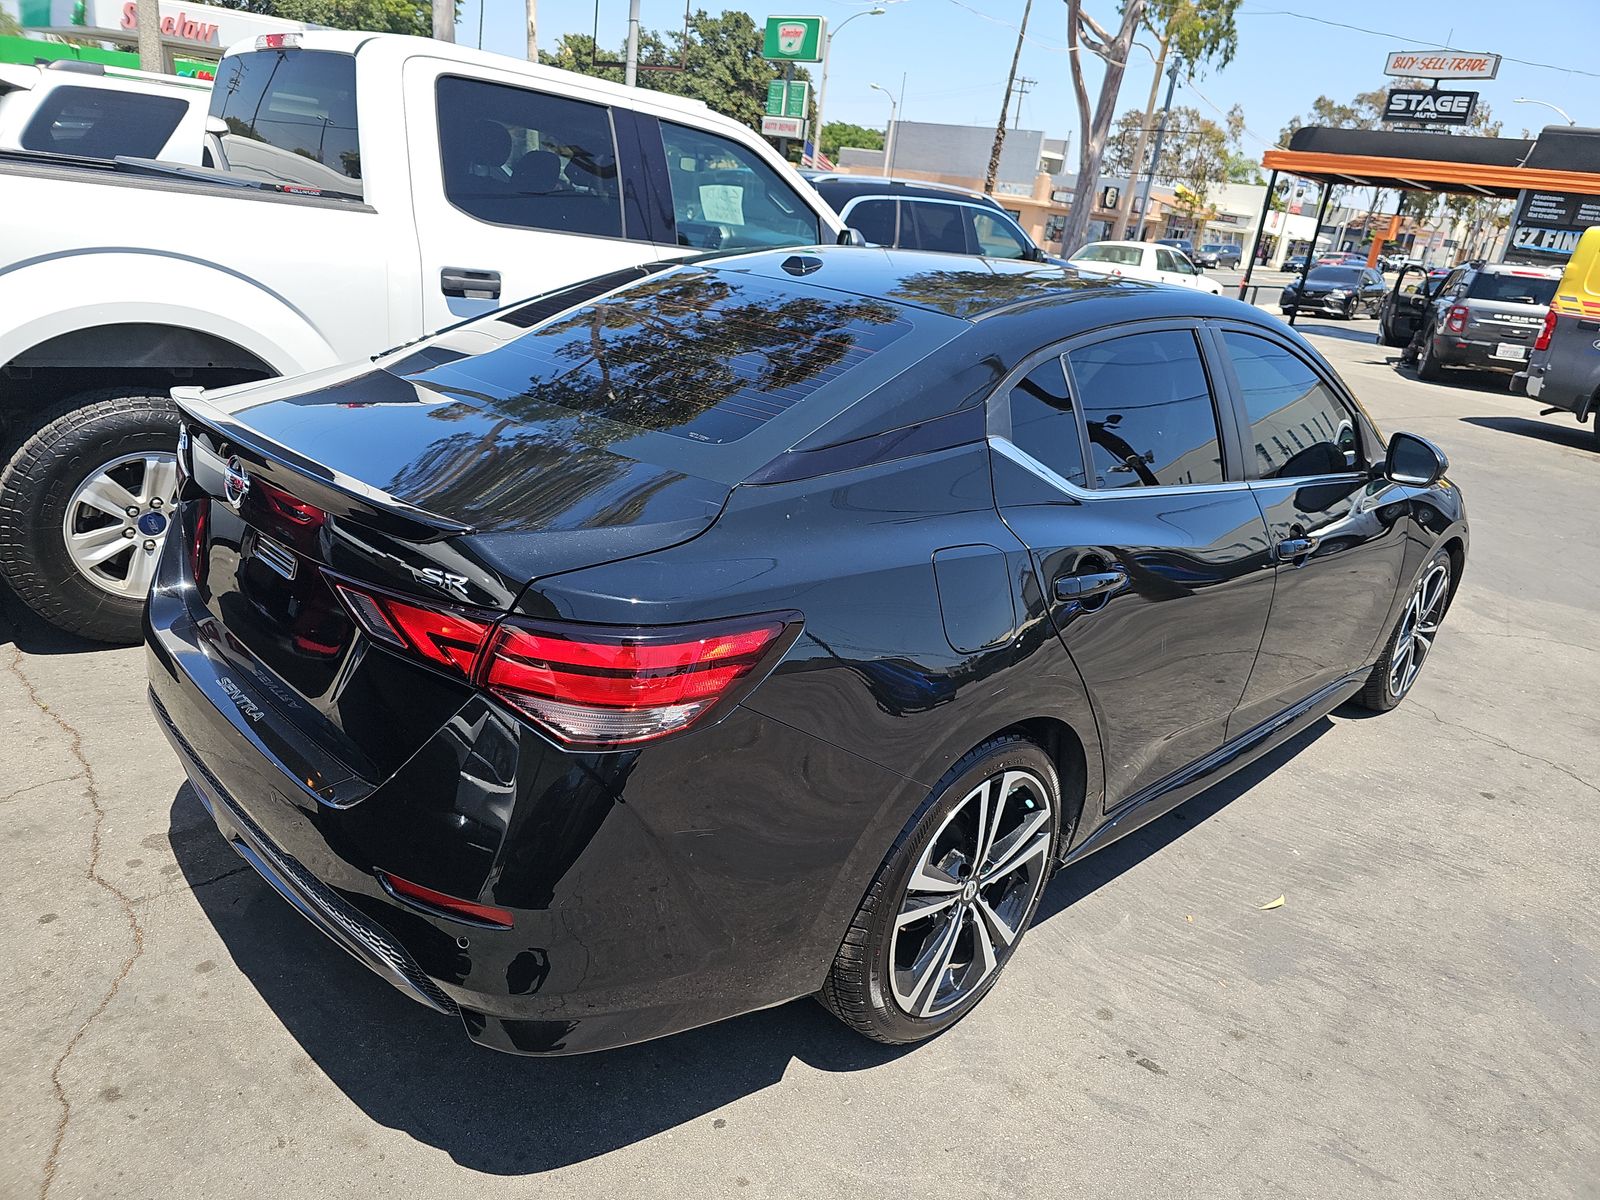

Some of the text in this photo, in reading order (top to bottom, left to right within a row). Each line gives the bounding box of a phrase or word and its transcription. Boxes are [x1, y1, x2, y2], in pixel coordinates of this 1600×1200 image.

[121, 2, 219, 42] Sclair
[1389, 94, 1471, 113] STAGE
[1513, 227, 1582, 252] EZ FIN
[421, 568, 469, 594] SR
[215, 676, 265, 722] SENTRA
